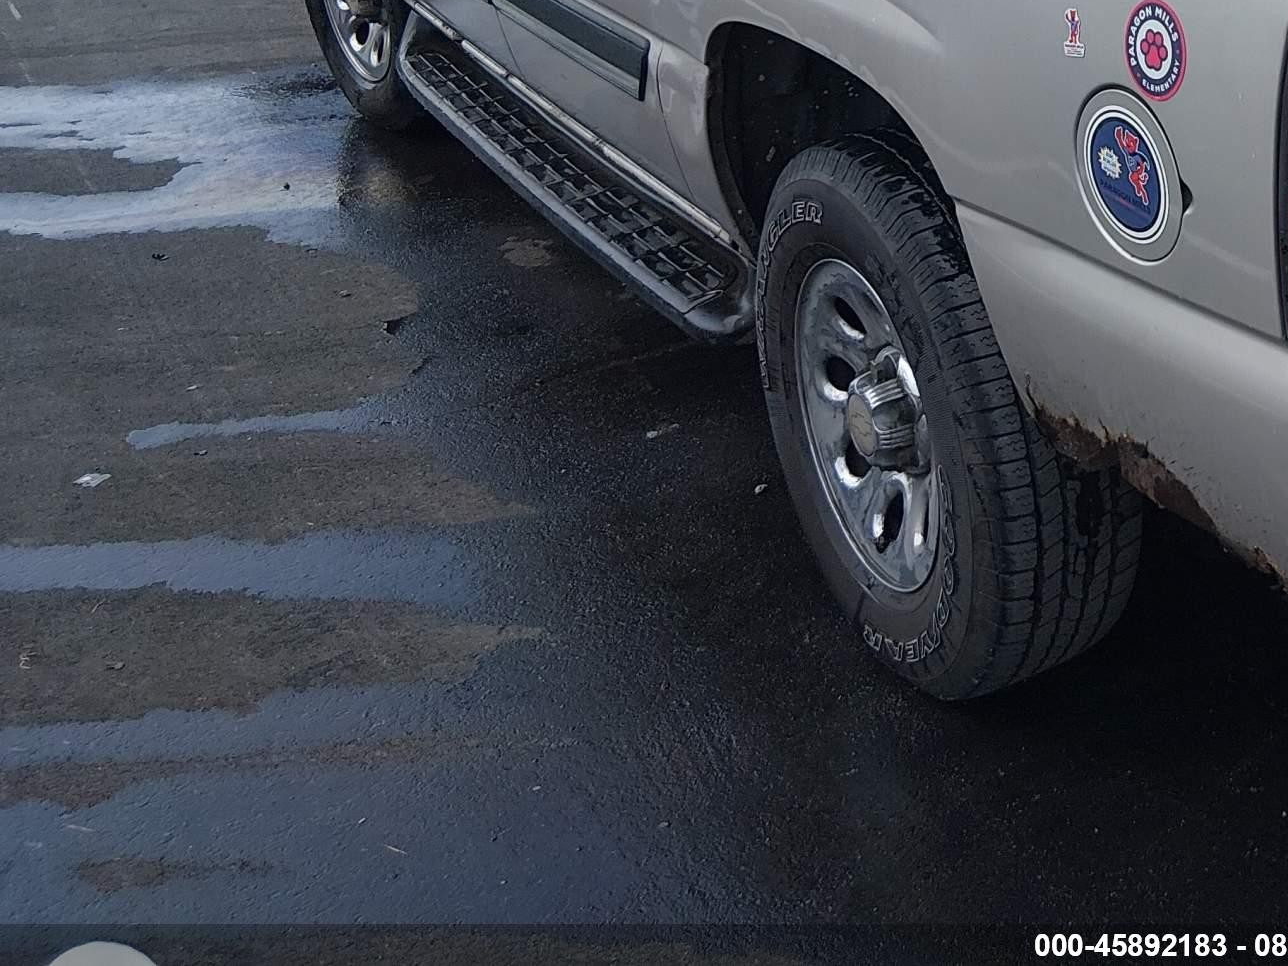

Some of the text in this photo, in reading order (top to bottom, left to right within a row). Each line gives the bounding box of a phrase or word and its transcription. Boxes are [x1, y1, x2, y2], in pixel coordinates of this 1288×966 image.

[1128, 6, 1179, 67] PARAGON MILLS
[1141, 58, 1181, 93] ELEMENTARY
